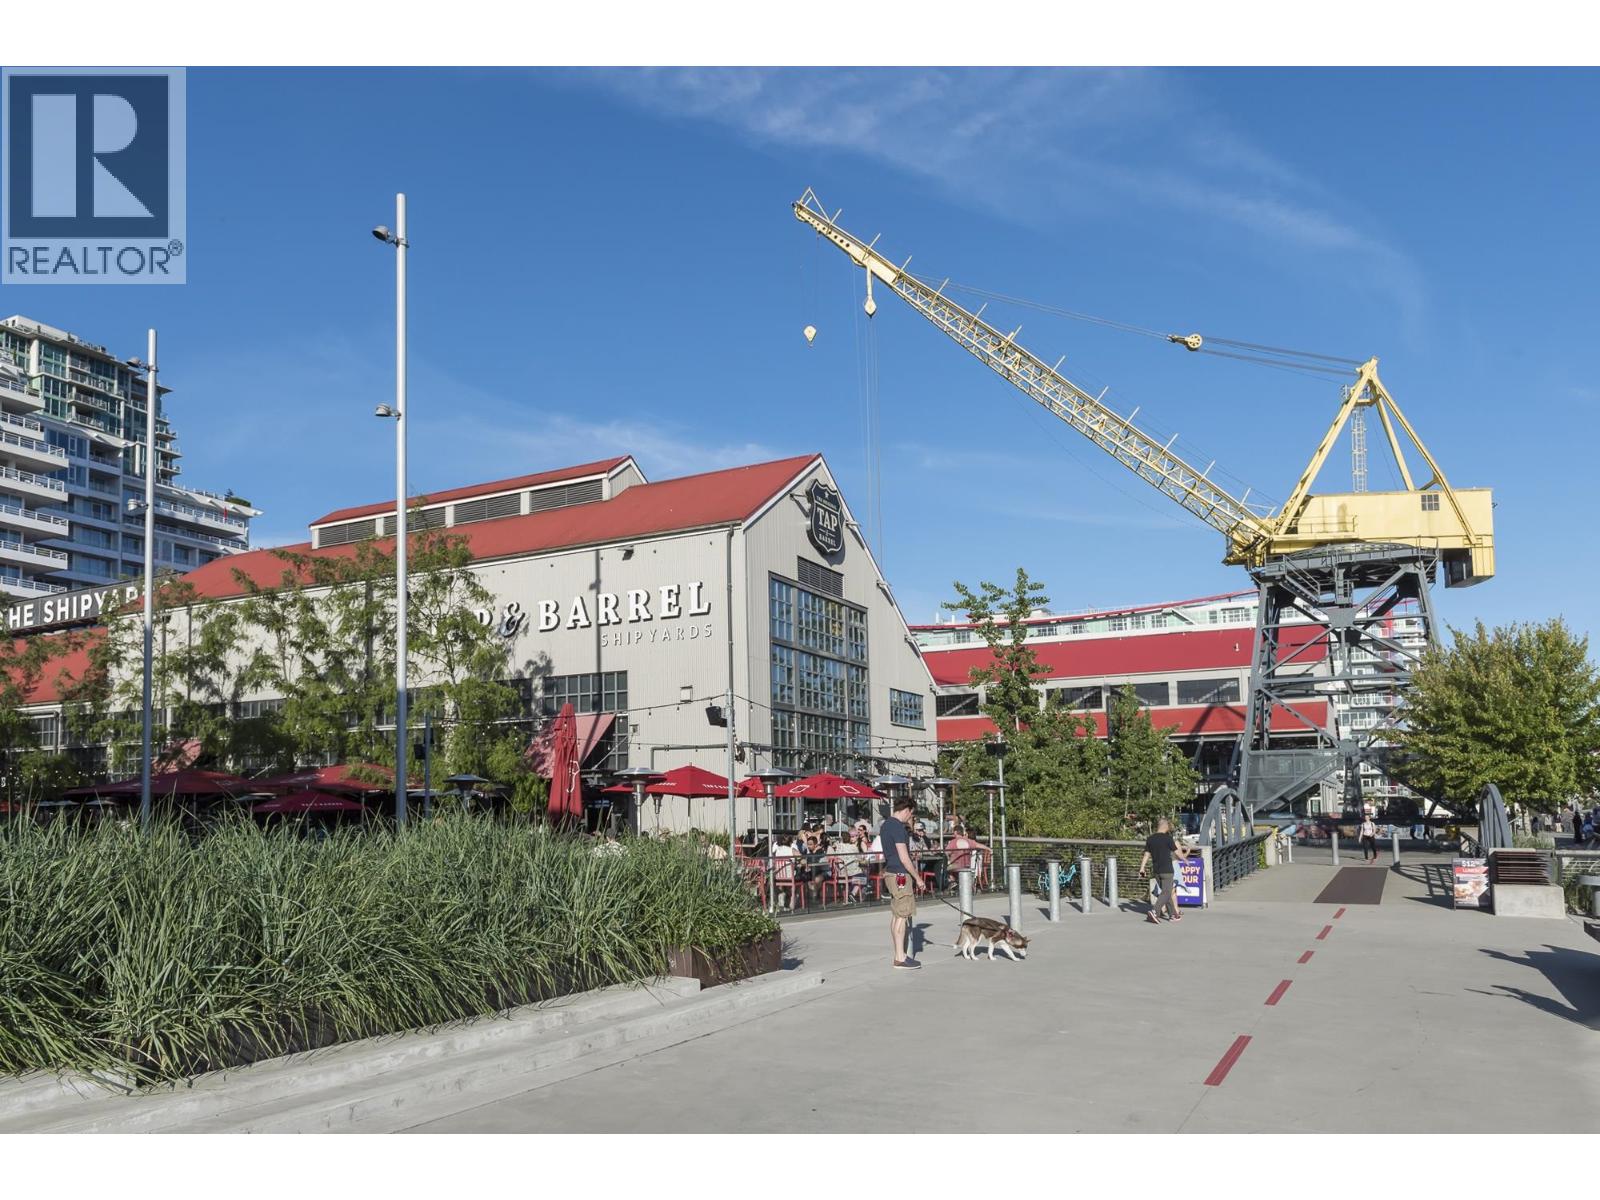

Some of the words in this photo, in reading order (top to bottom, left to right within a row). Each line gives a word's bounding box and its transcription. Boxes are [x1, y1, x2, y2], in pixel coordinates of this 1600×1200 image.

[816, 506, 838, 532] TAP
[0, 604, 34, 630] HE
[501, 601, 526, 639] &
[538, 581, 711, 632] BARREL
[601, 623, 713, 648] SHIPYARDS
[1181, 866, 1200, 875] APPY
[1182, 875, 1199, 884] OUR
